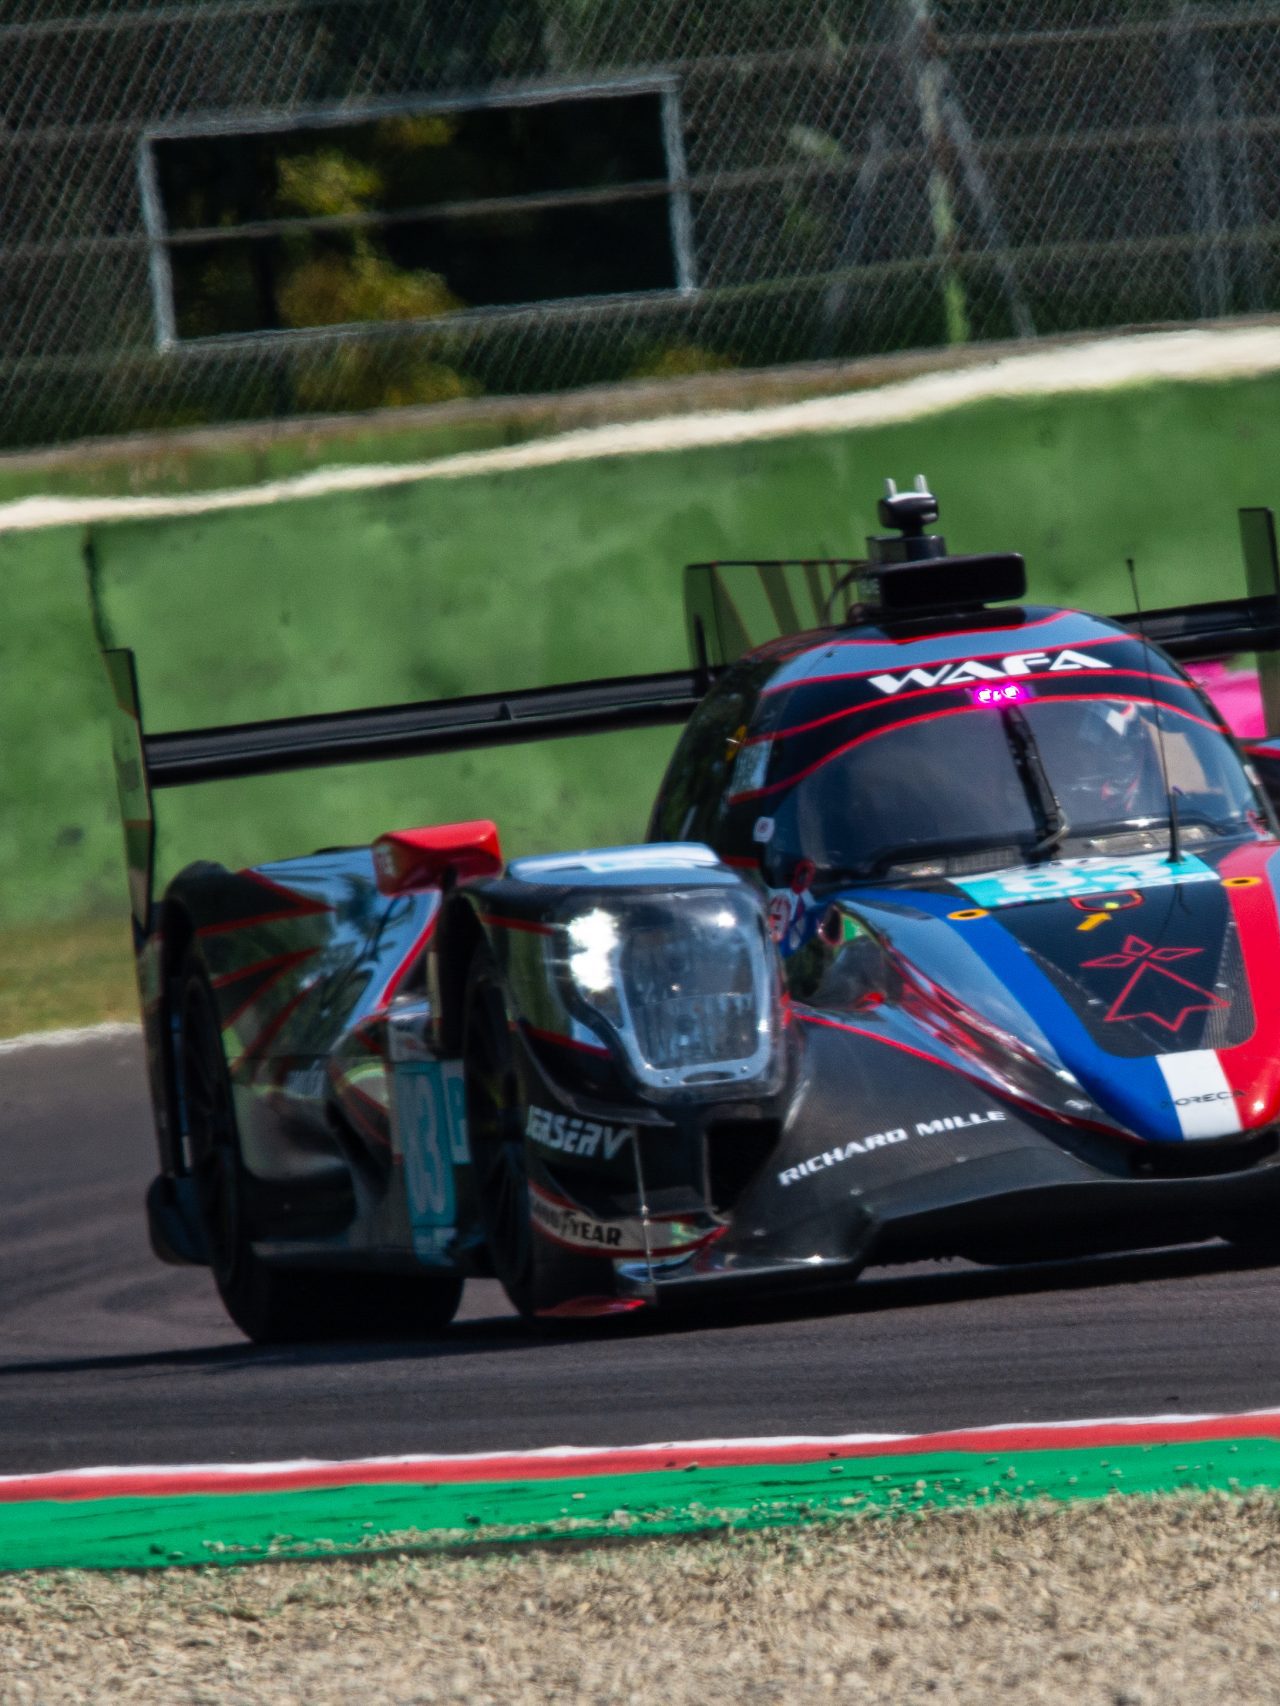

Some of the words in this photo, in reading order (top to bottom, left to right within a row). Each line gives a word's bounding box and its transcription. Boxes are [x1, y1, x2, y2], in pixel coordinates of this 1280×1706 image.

[867, 650, 1112, 694] WAFA
[1001, 860, 1173, 893] 83
[778, 1128, 908, 1186] RICHARD
[915, 1110, 1007, 1137] MILLE
